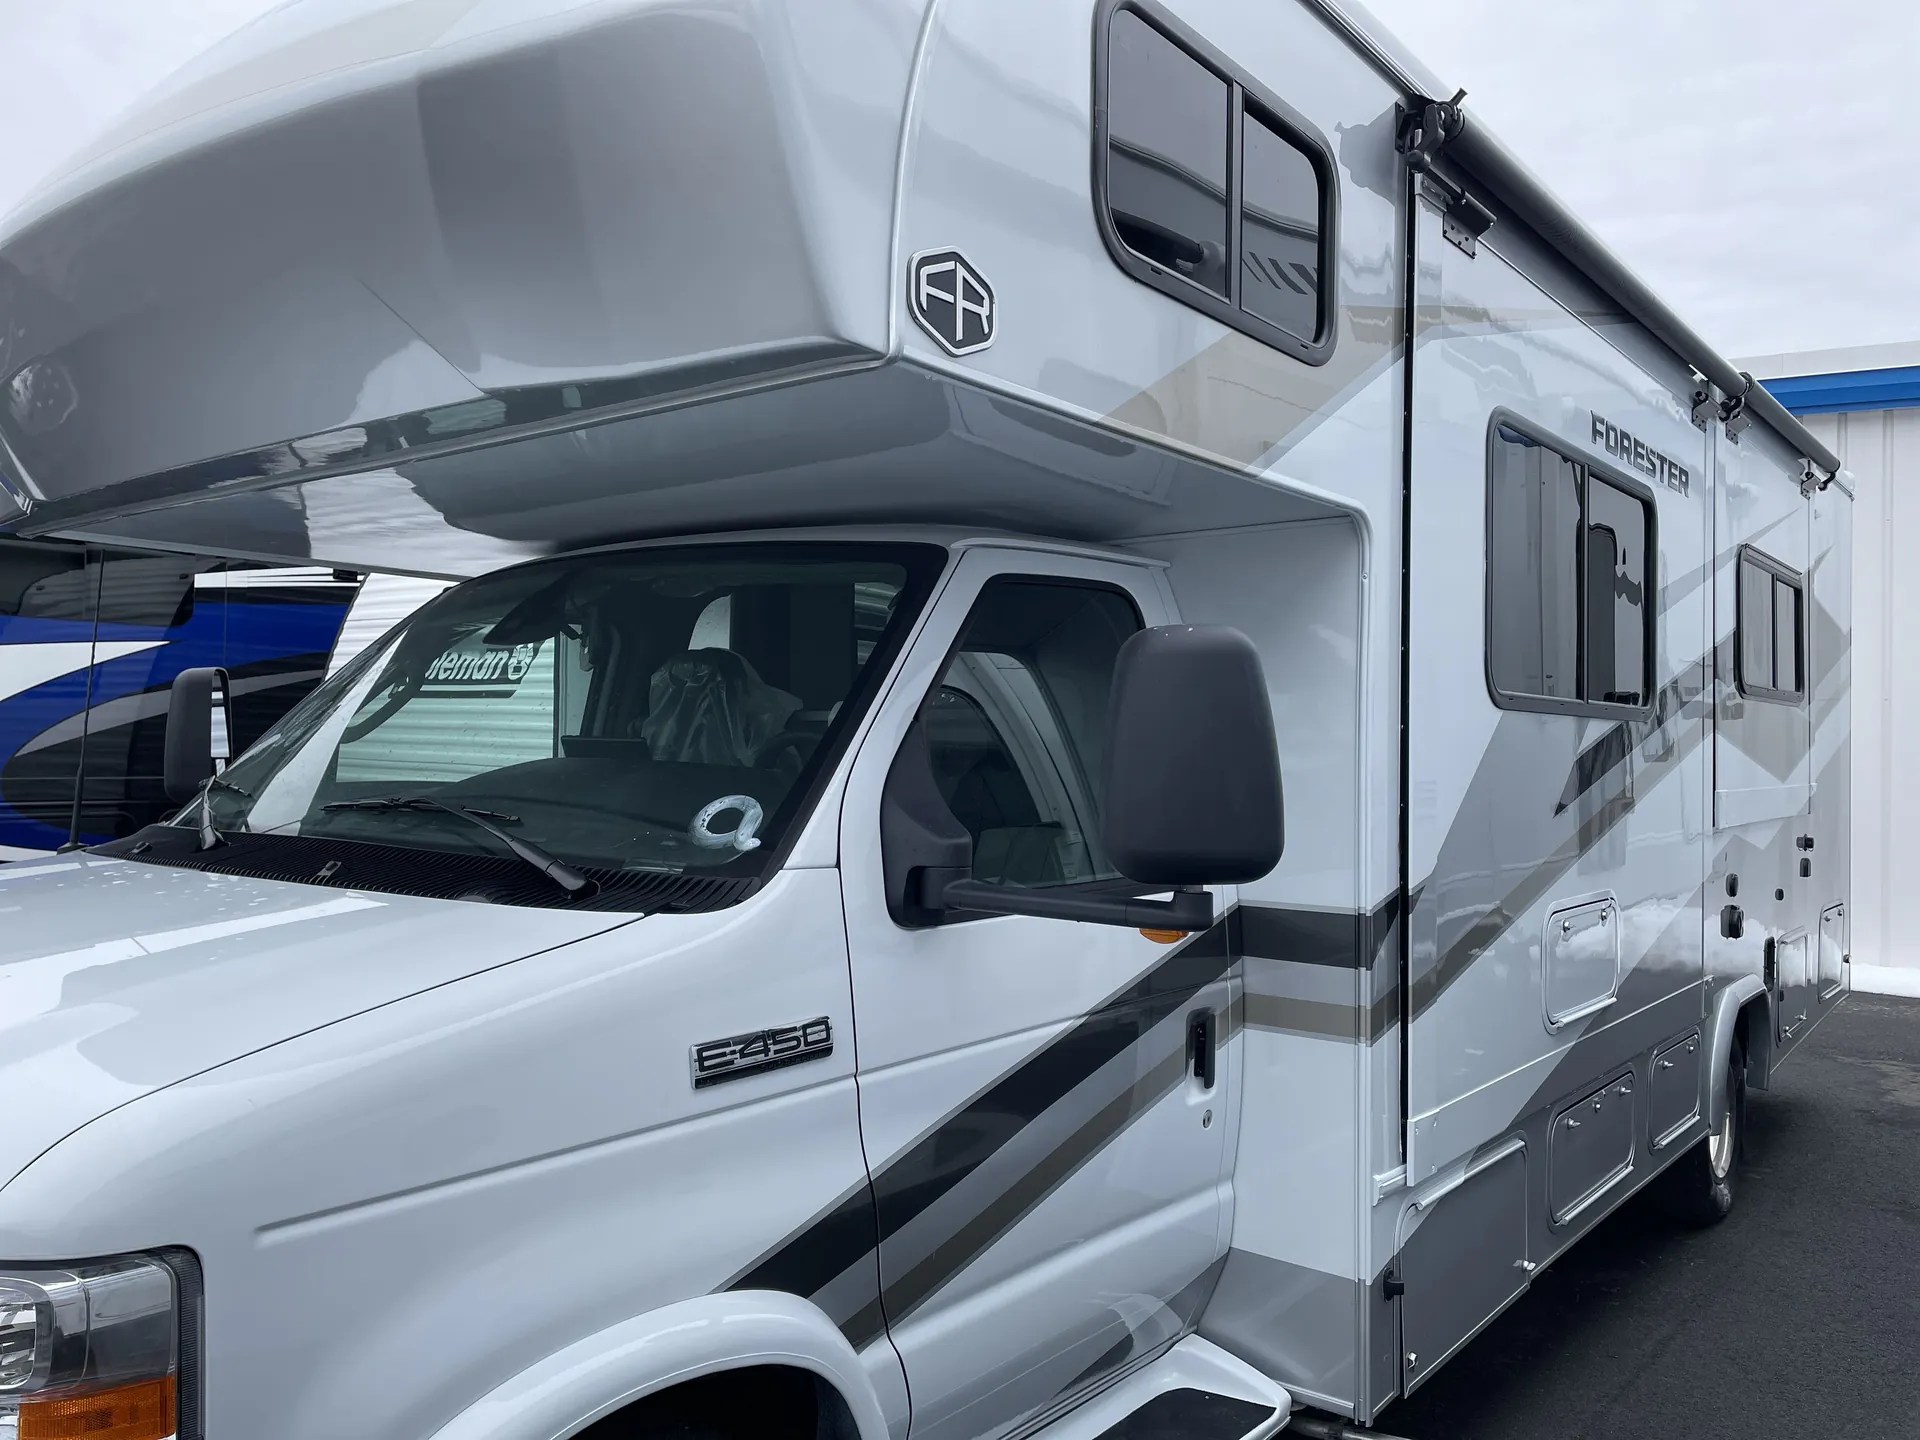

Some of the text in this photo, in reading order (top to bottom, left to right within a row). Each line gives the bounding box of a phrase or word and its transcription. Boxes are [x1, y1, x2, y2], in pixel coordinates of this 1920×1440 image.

[919, 260, 990, 342] FR
[1590, 410, 1690, 499] FORESTER
[696, 1018, 832, 1073] E-450
